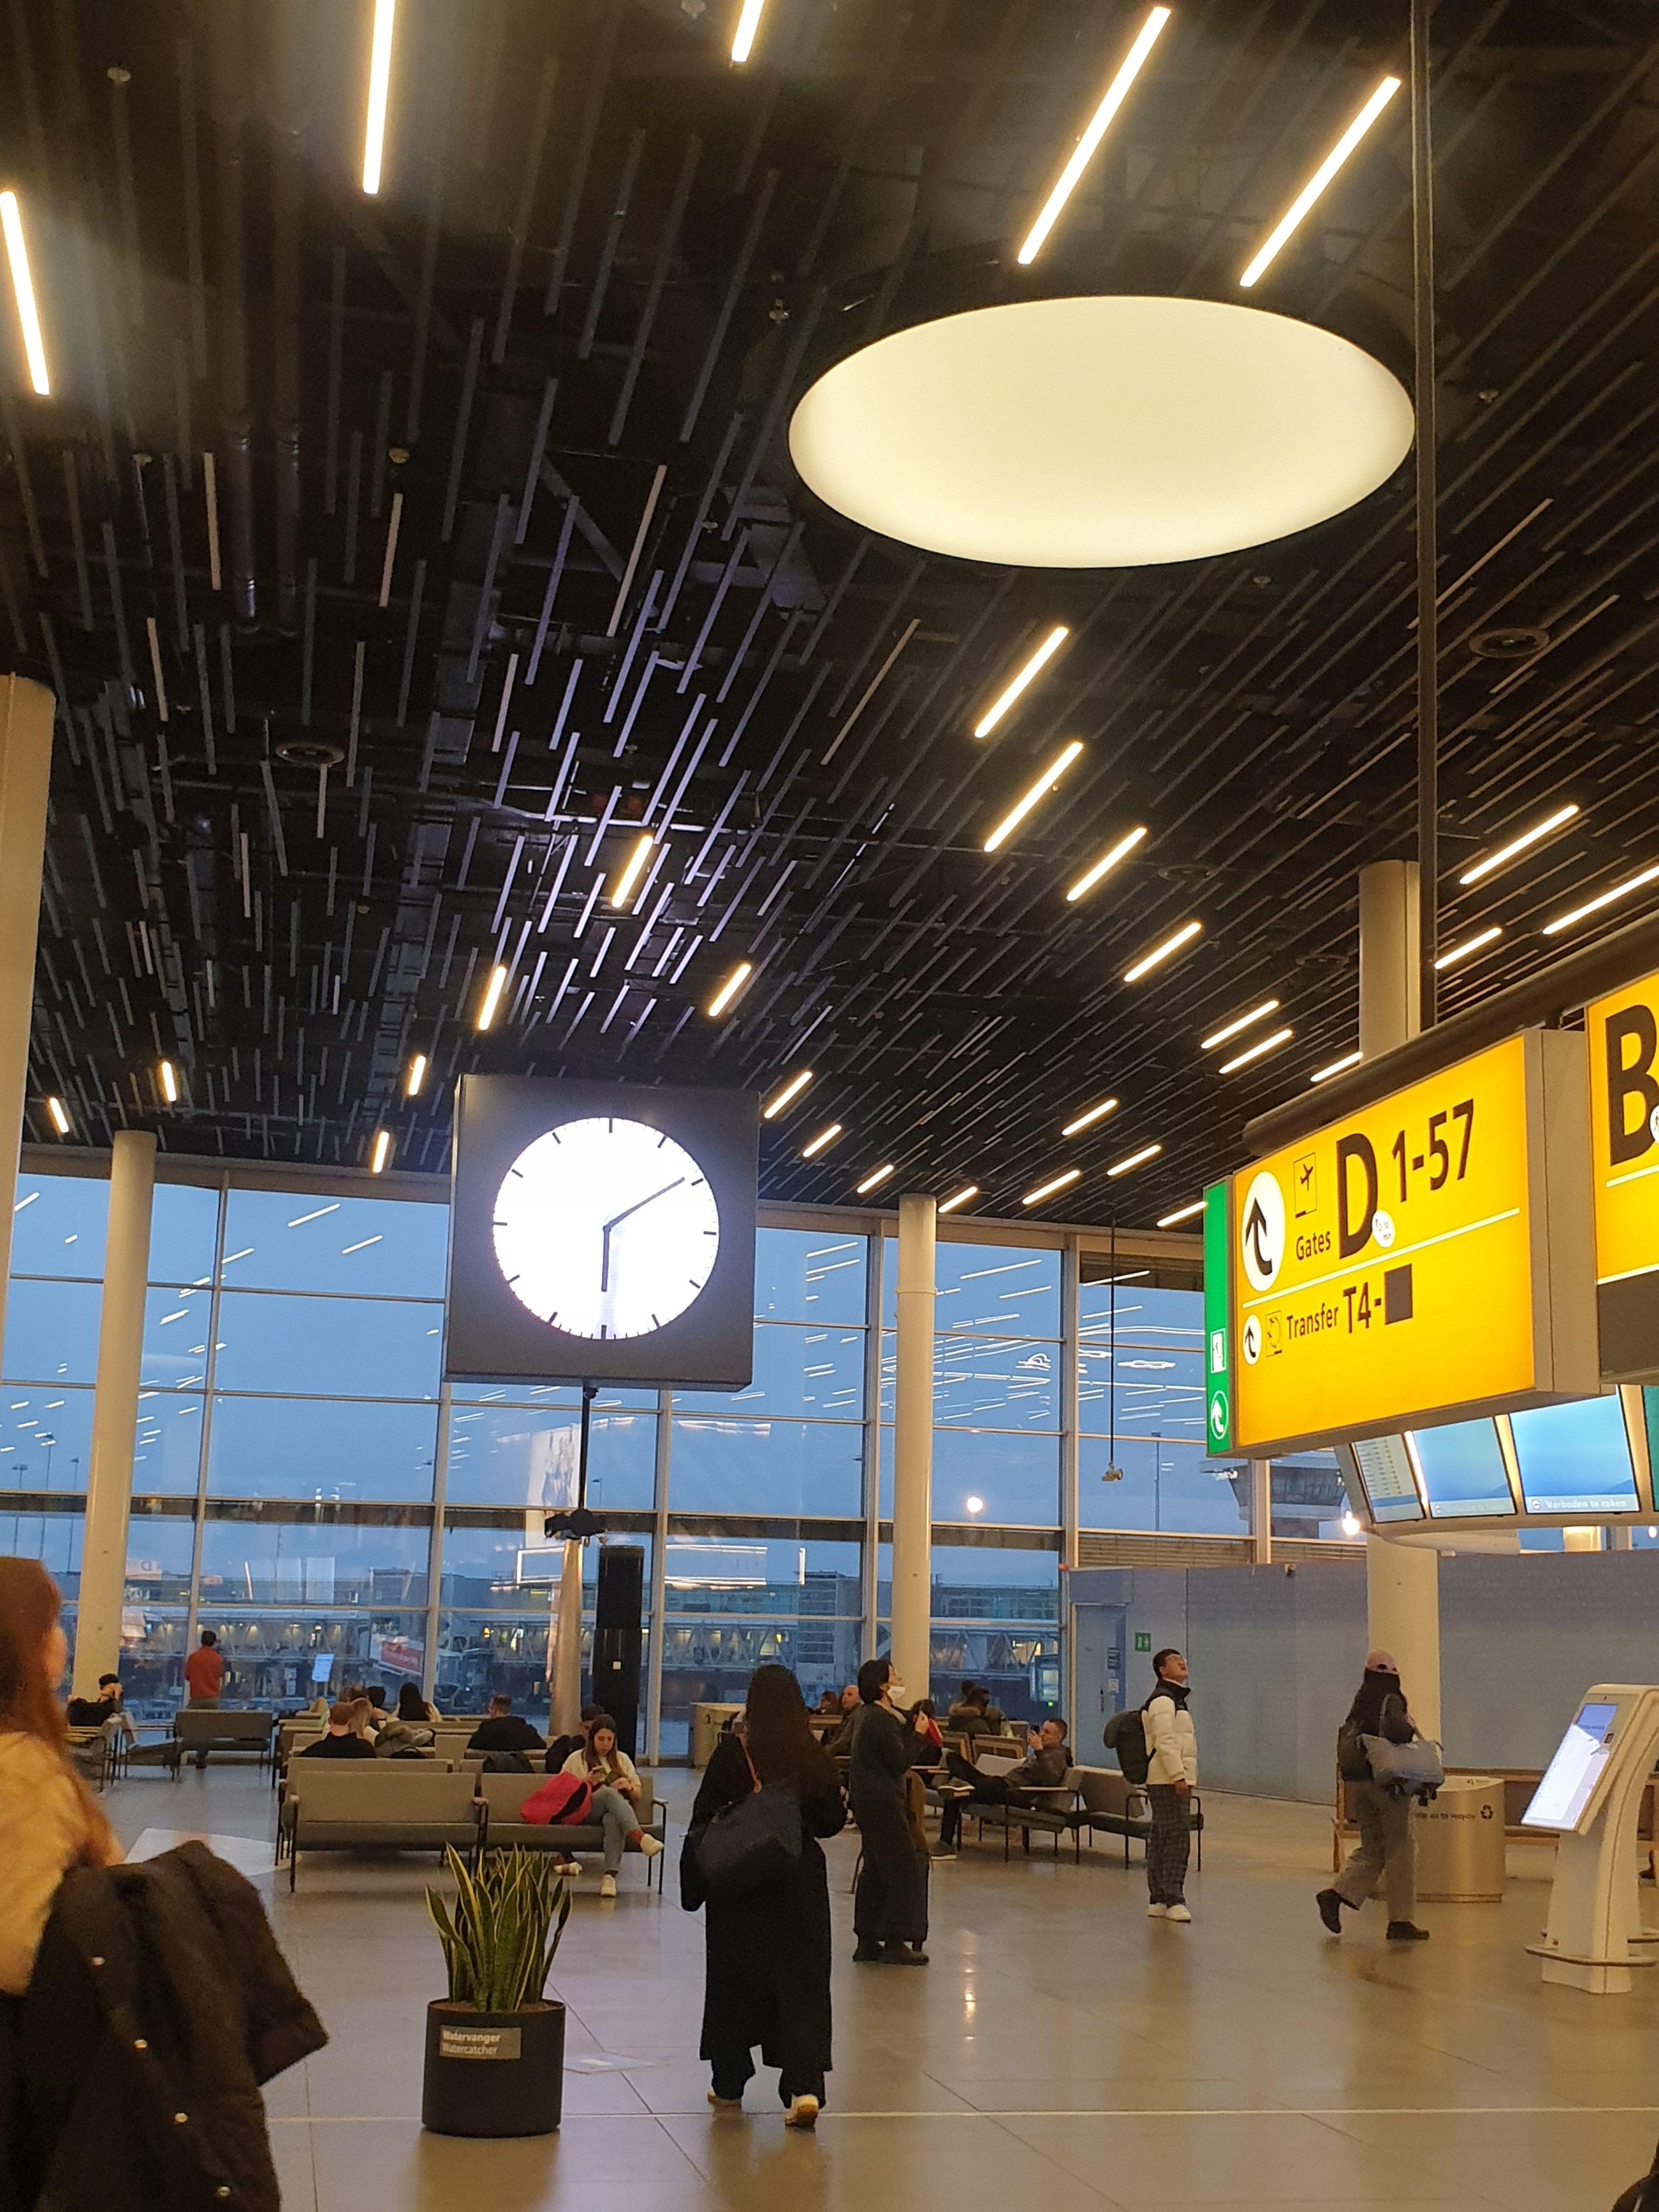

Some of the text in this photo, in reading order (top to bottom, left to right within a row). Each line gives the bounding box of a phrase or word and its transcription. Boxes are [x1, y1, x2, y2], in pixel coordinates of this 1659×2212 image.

[1605, 1005, 1659, 1167] B
[1296, 1098, 1474, 1261] Gates D 1-57
[1286, 1302, 1339, 1340] Transfer
[1545, 1499, 1627, 1509] Verboden te roken
[442, 2030, 501, 2044] Watervanger
[442, 2042, 498, 2055] Watercatcher
